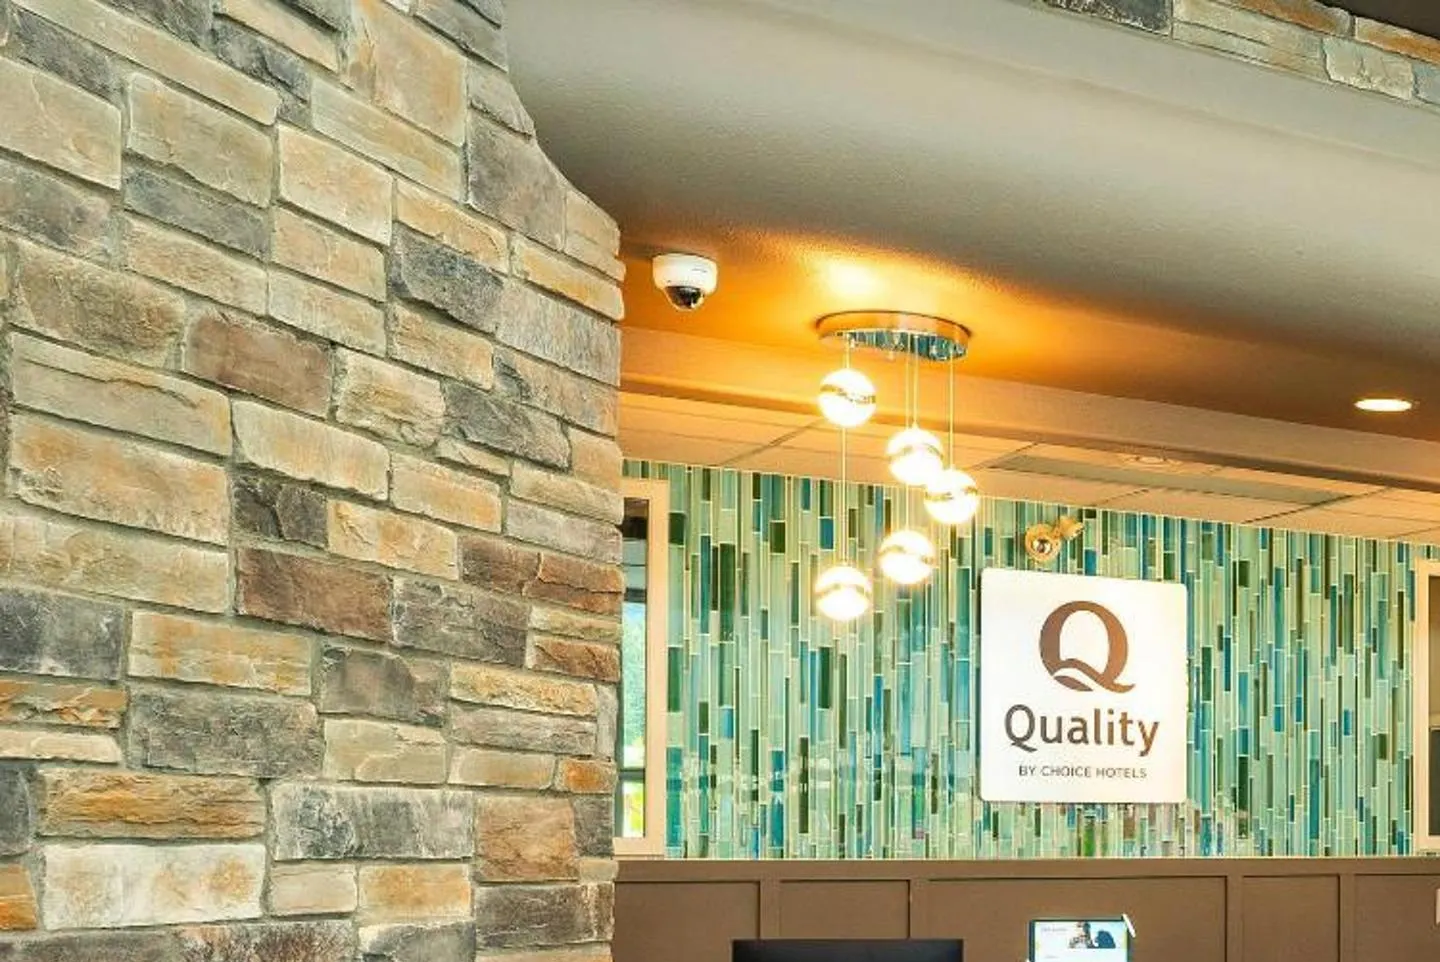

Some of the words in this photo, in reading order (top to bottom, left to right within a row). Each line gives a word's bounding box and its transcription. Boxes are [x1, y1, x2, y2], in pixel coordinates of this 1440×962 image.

[1039, 600, 1136, 693] Q
[1004, 704, 1160, 757] Quality
[1019, 765, 1036, 777] BY
[1041, 765, 1091, 778] CHOICE
[1096, 767, 1147, 778] HOTELS
